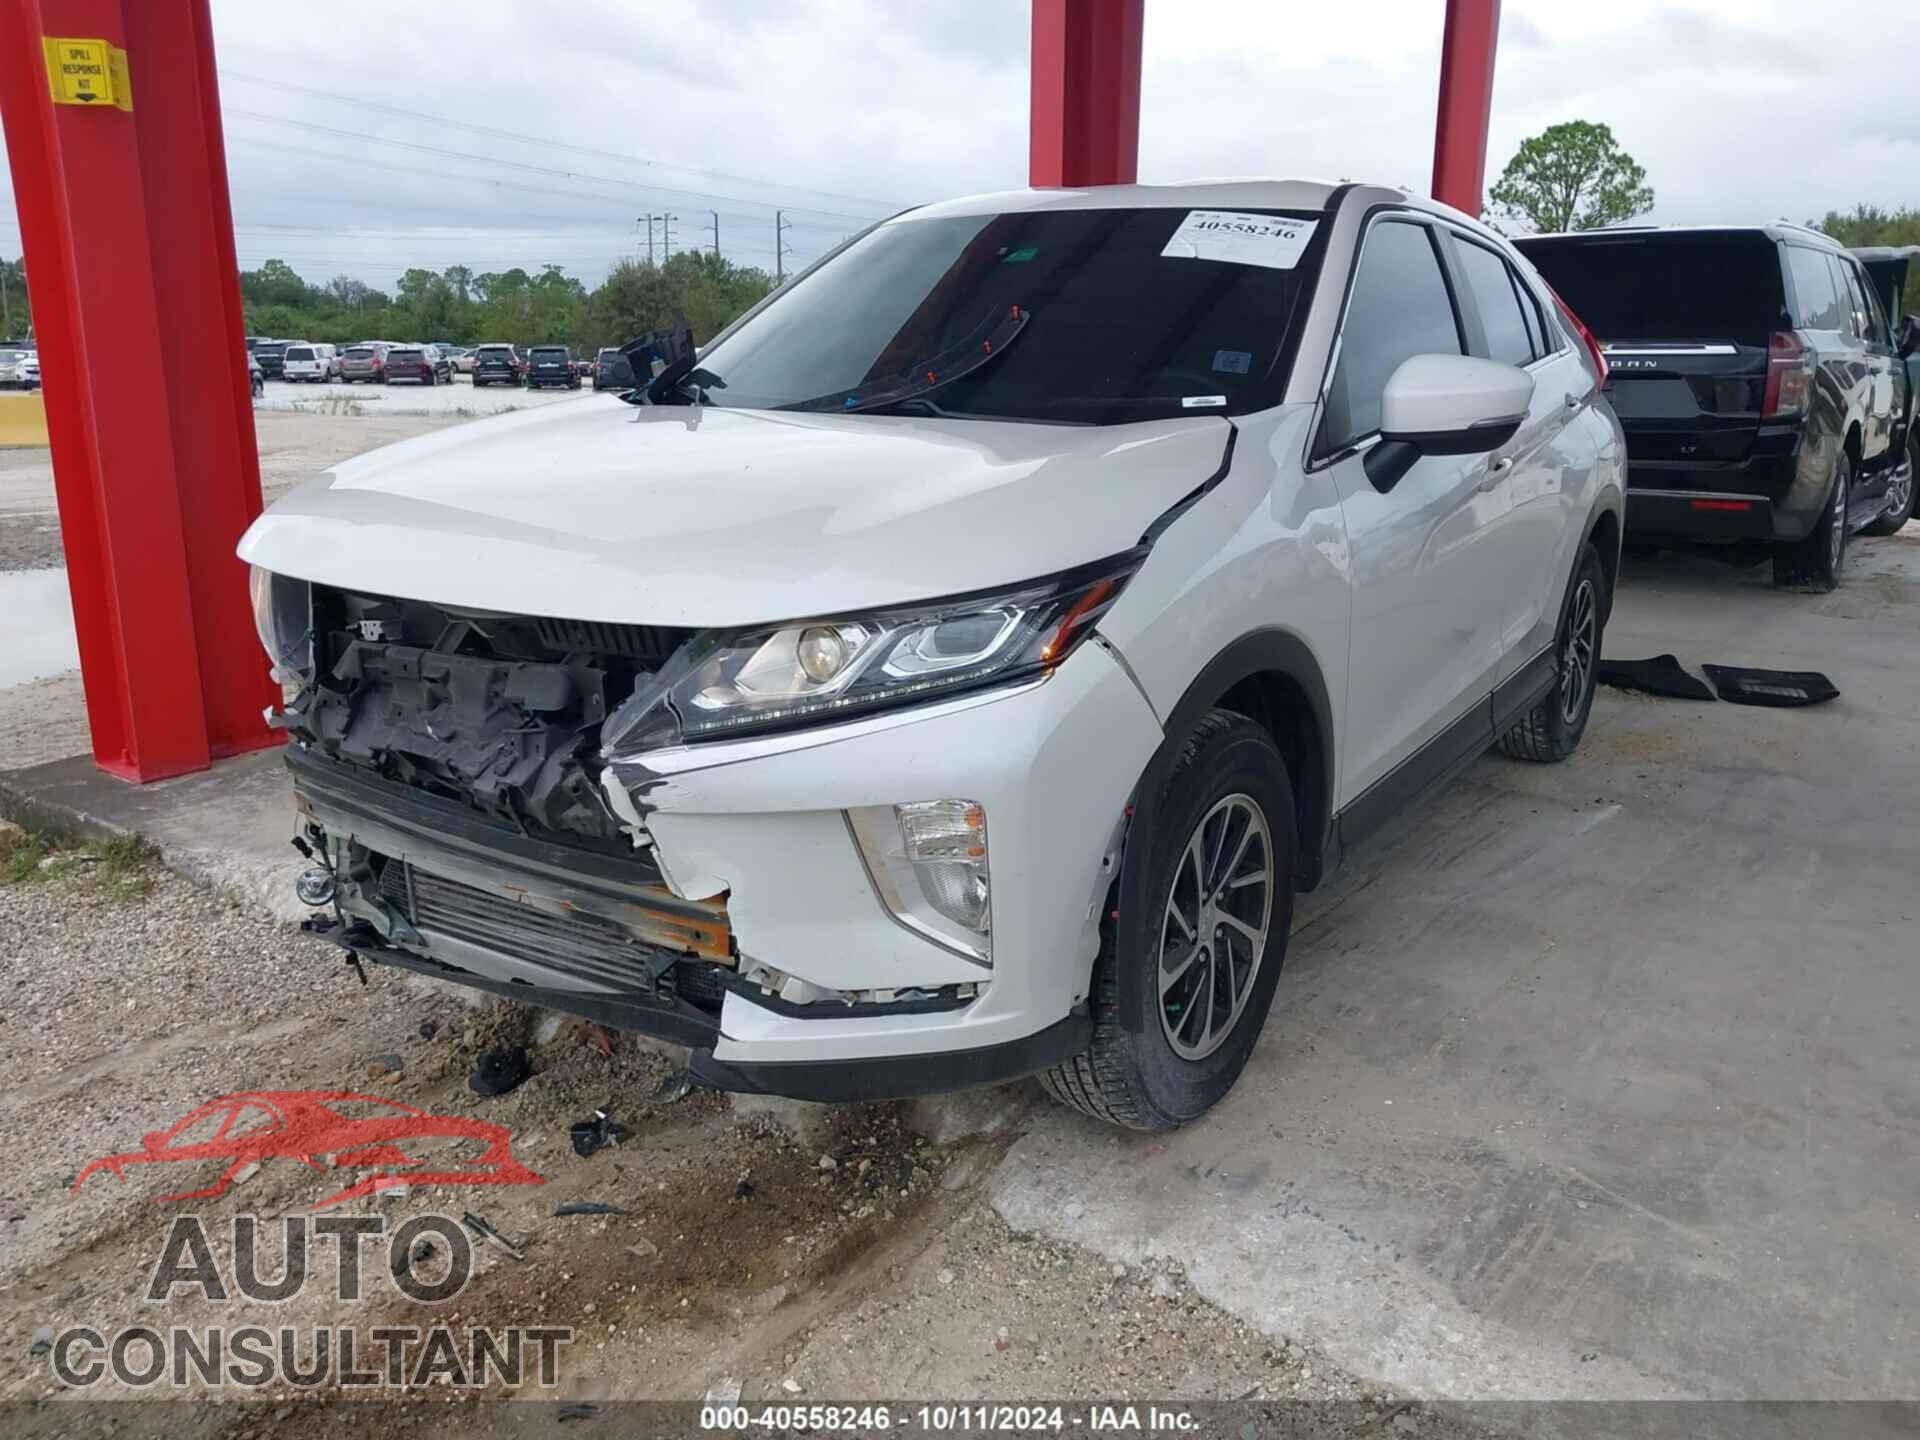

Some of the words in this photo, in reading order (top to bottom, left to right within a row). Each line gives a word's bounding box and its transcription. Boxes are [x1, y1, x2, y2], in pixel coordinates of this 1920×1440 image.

[69, 49, 90, 60] SPILL
[62, 64, 102, 75] RESPONSE
[78, 79, 90, 89] KIT
[1194, 220, 1296, 240] 40558246
